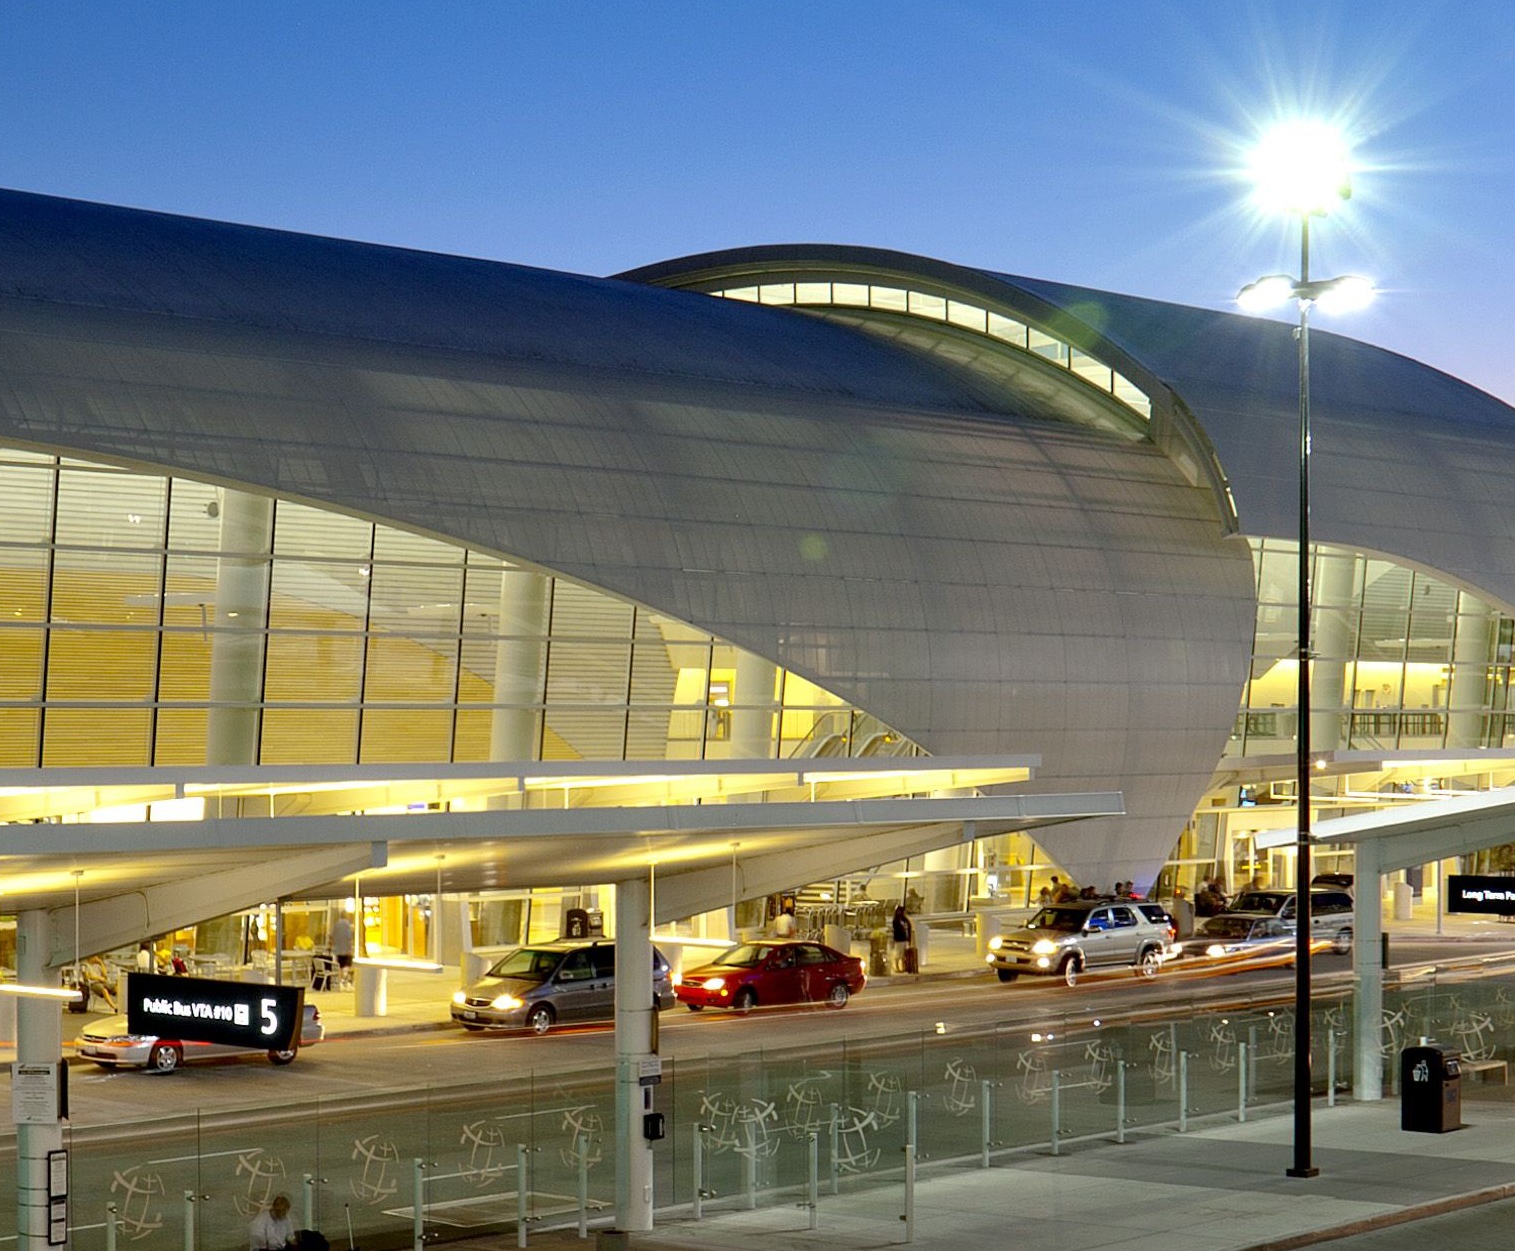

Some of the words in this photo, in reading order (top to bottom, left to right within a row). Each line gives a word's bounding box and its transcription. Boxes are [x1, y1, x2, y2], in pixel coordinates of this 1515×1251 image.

[1462, 889, 1484, 902] Long
[1483, 890, 1505, 900] Term
[143, 997, 173, 1015] Public
[173, 1000, 191, 1017] Bus
[191, 1002, 213, 1019] VTA
[213, 1005, 233, 1021] #10
[261, 998, 278, 1035] 5
